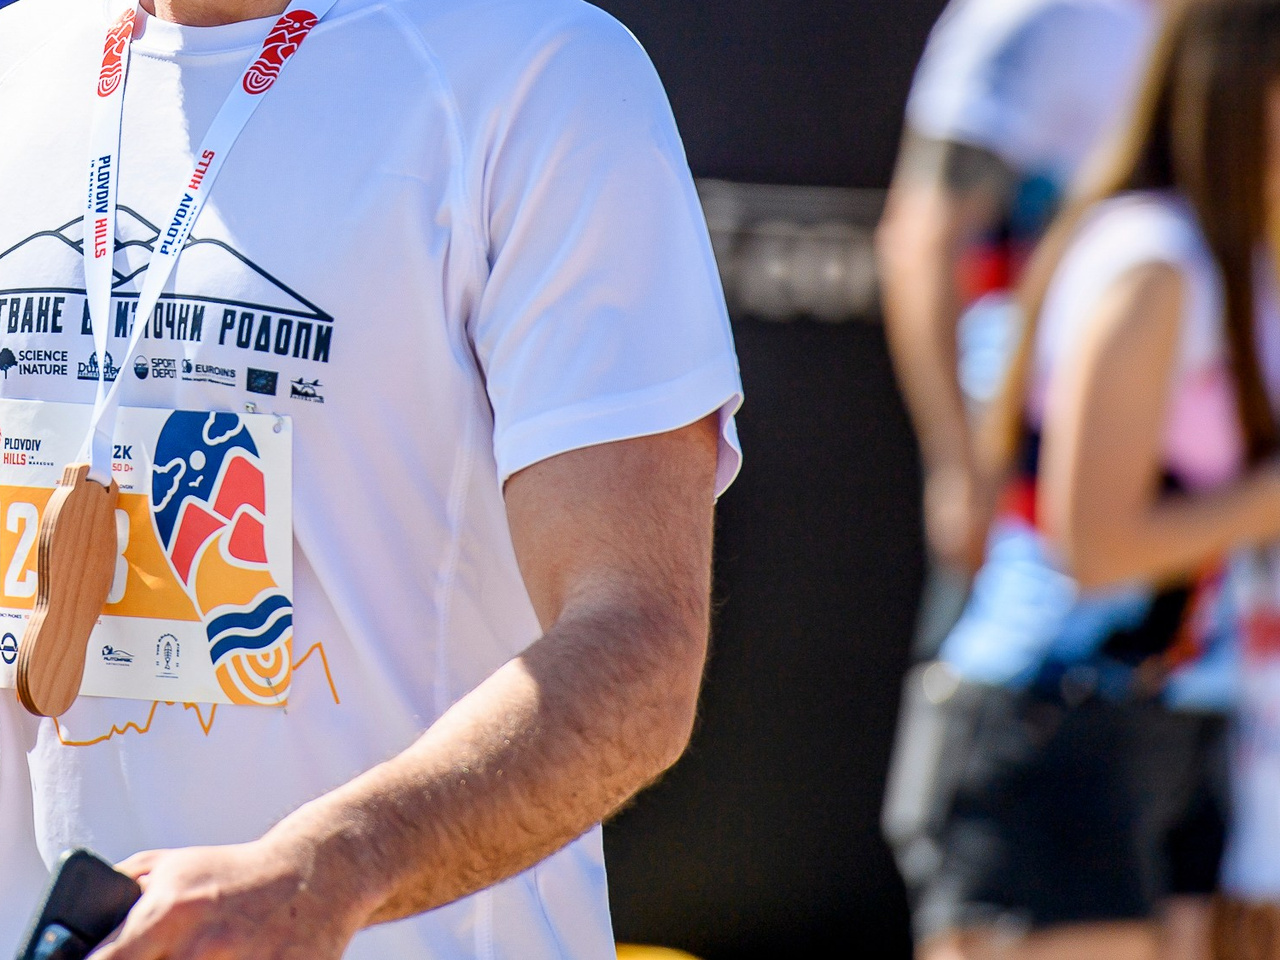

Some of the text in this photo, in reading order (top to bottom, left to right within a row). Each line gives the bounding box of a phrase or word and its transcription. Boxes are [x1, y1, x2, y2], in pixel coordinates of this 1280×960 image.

[95, 154, 111, 259] PLOVDIV HILLS
[160, 193, 193, 255] PLOVDIV
[188, 149, 215, 190] HILLS
[218, 308, 333, 363] РОДОПИ
[19, 350, 68, 362] SCIENCE
[151, 358, 176, 368] SPORT
[152, 368, 177, 379] DEPOT
[4, 437, 42, 451] PLOVDIV
[3, 452, 26, 466] HILLS
[113, 445, 133, 460] 2K
